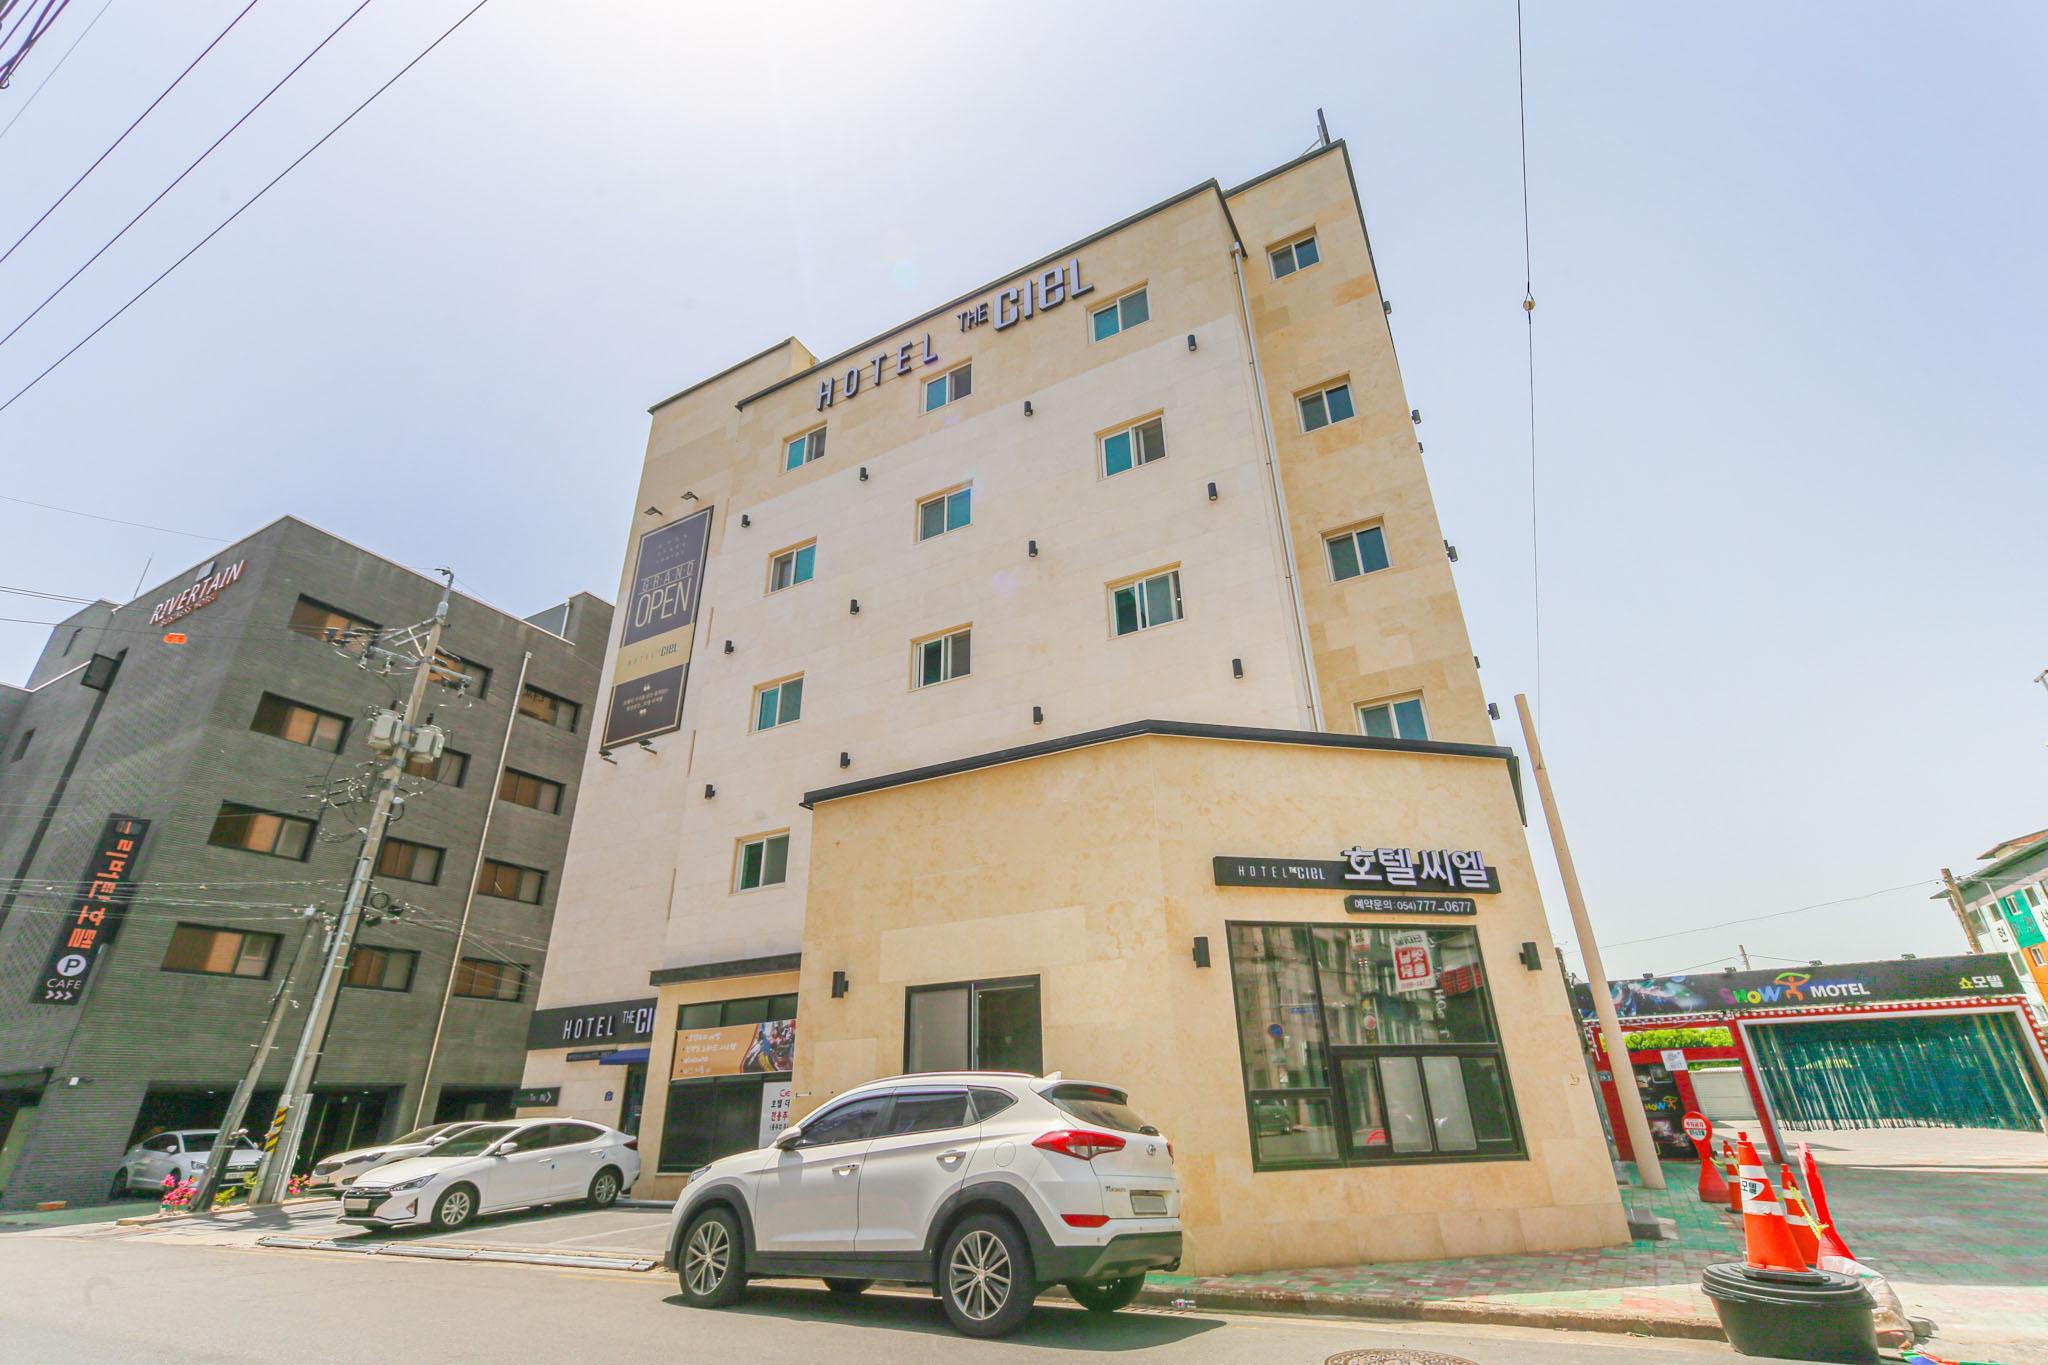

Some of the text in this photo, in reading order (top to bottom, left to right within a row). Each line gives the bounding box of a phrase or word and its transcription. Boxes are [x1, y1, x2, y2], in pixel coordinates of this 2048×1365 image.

[816, 332, 939, 412] HOTEL
[957, 302, 989, 333] THE
[149, 559, 248, 625] RIVERTAIN
[635, 577, 692, 628] OPEN
[1238, 864, 1288, 879] HOTEL
[1288, 866, 1297, 874] THE
[1341, 845, 1490, 889] 호텔씨엘
[46, 978, 82, 990] CAFE
[1719, 982, 1871, 1005] SHOW MOTEL
[562, 1007, 656, 1041] HOTEL THE CI
